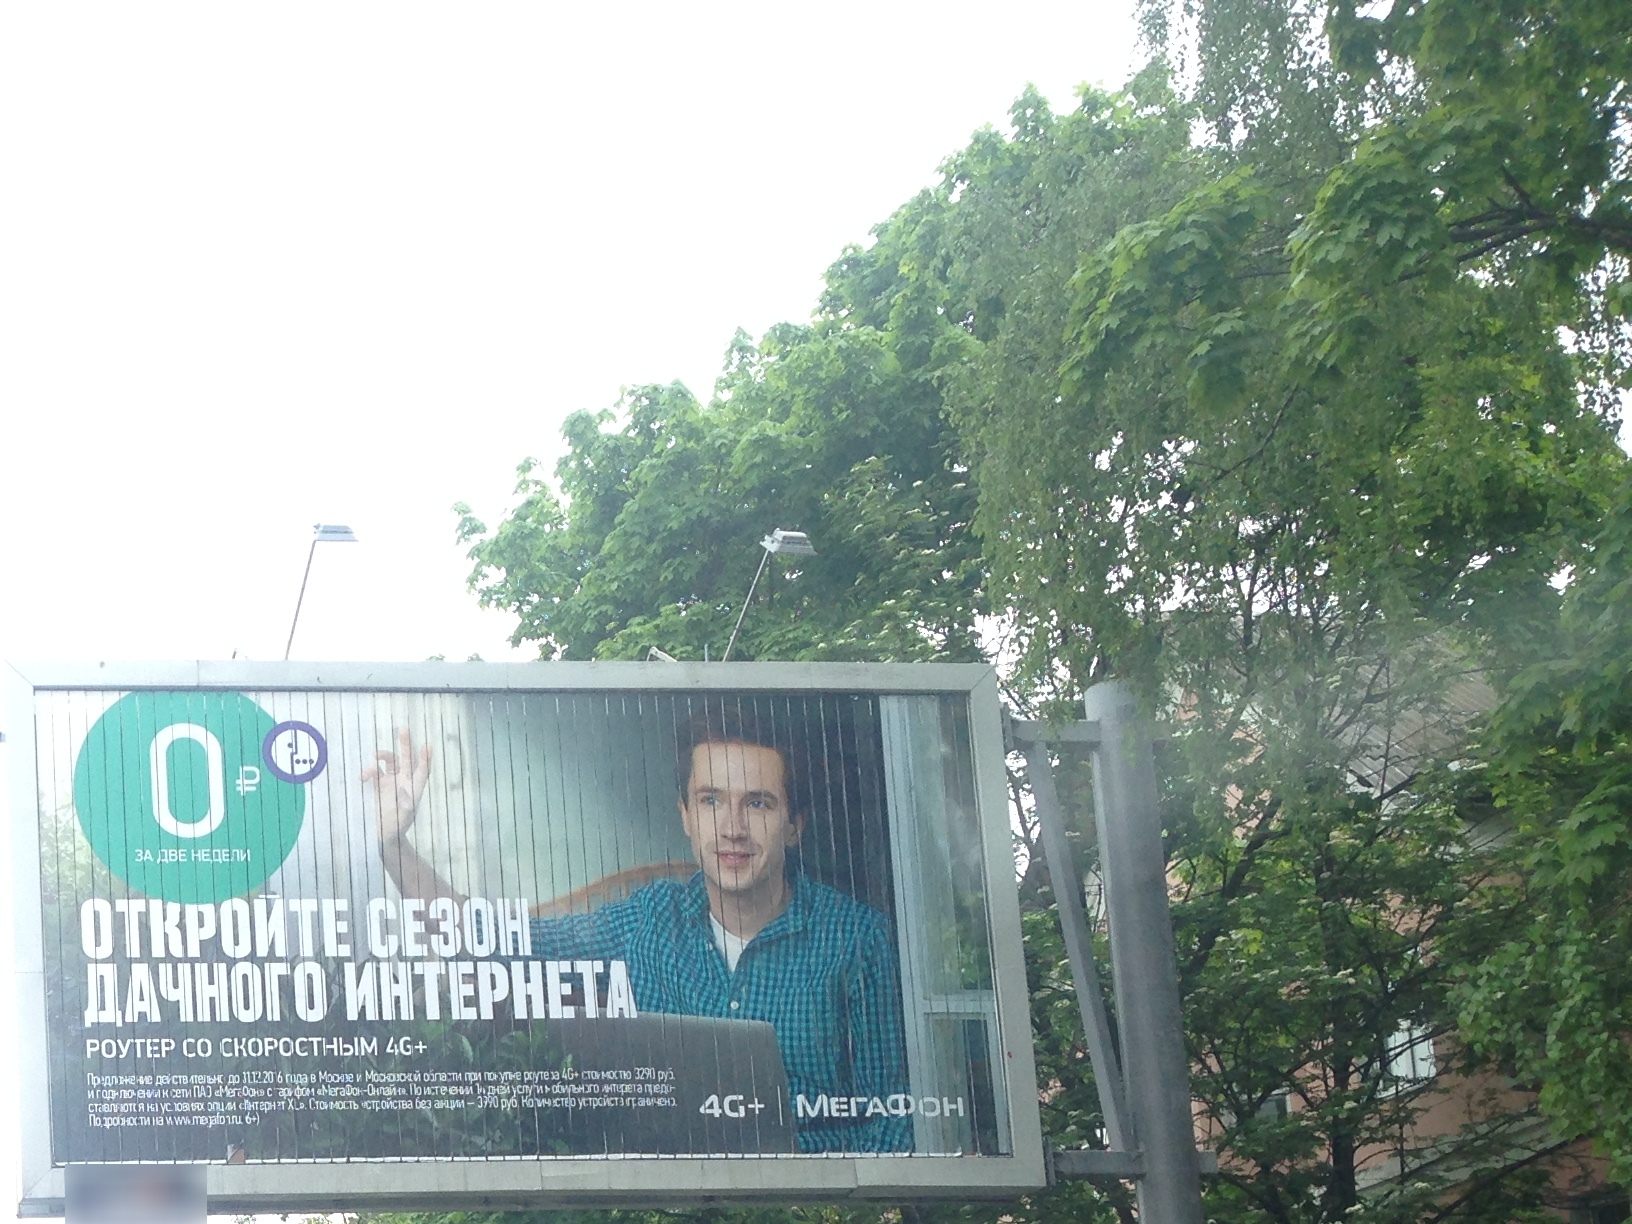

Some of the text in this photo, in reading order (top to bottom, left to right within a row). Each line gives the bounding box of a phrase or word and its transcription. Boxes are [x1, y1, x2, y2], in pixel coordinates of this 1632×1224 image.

[150, 722, 225, 838] 0
[134, 848, 251, 863] ЗА ДВЕ НЕДЕЛИ
[80, 894, 532, 959] ОТКРОЙТЕ СЕЗОН
[84, 960, 638, 1027] ДАЧНОГО ИНТЕРНЕТА
[86, 1036, 428, 1059] РОУТЕР СО СКОРОСТНЫМ 4G+
[228, 1074, 240, 1085] до
[242, 1071, 283, 1084] 31.12.206
[286, 1073, 308, 1085] года
[310, 1073, 316, 1083] в
[464, 1071, 482, 1084] при
[561, 1067, 579, 1080] 4G+
[581, 1070, 632, 1080] стоимостю
[87, 1089, 94, 1099] и
[162, 1088, 168, 1099] к
[170, 1088, 192, 1099] сети
[266, 1087, 273, 1097] с
[409, 1083, 422, 1096] По
[602, 1083, 643, 1096] интерета
[415, 1096, 432, 1110] без
[699, 1094, 765, 1118] 4G+
